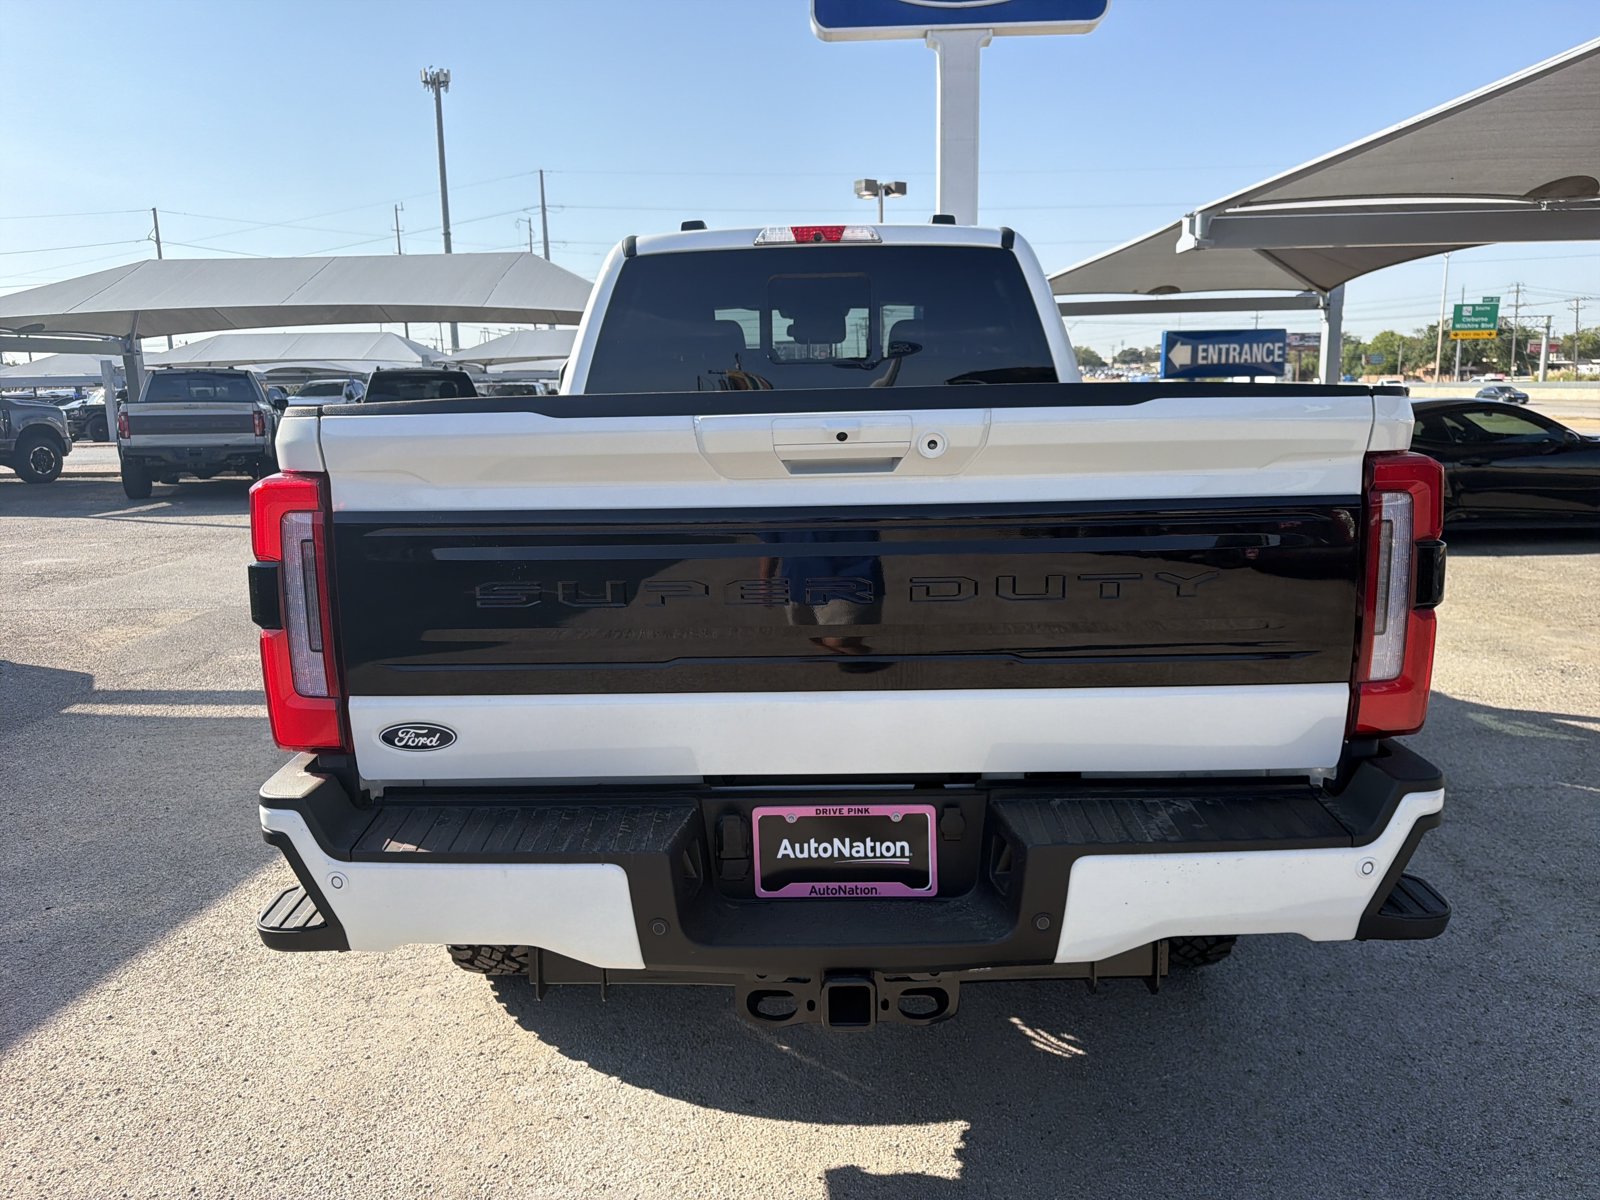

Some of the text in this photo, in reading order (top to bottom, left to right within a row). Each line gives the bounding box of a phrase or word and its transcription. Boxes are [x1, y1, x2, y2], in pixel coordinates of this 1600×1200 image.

[1197, 342, 1284, 365] ENTRANCE
[474, 569, 1222, 608] SUPER DUTY
[394, 728, 441, 747] Ford
[815, 807, 871, 816] DRIVE PINK
[776, 836, 911, 859] AutoNation
[808, 884, 879, 896] AutoNation
